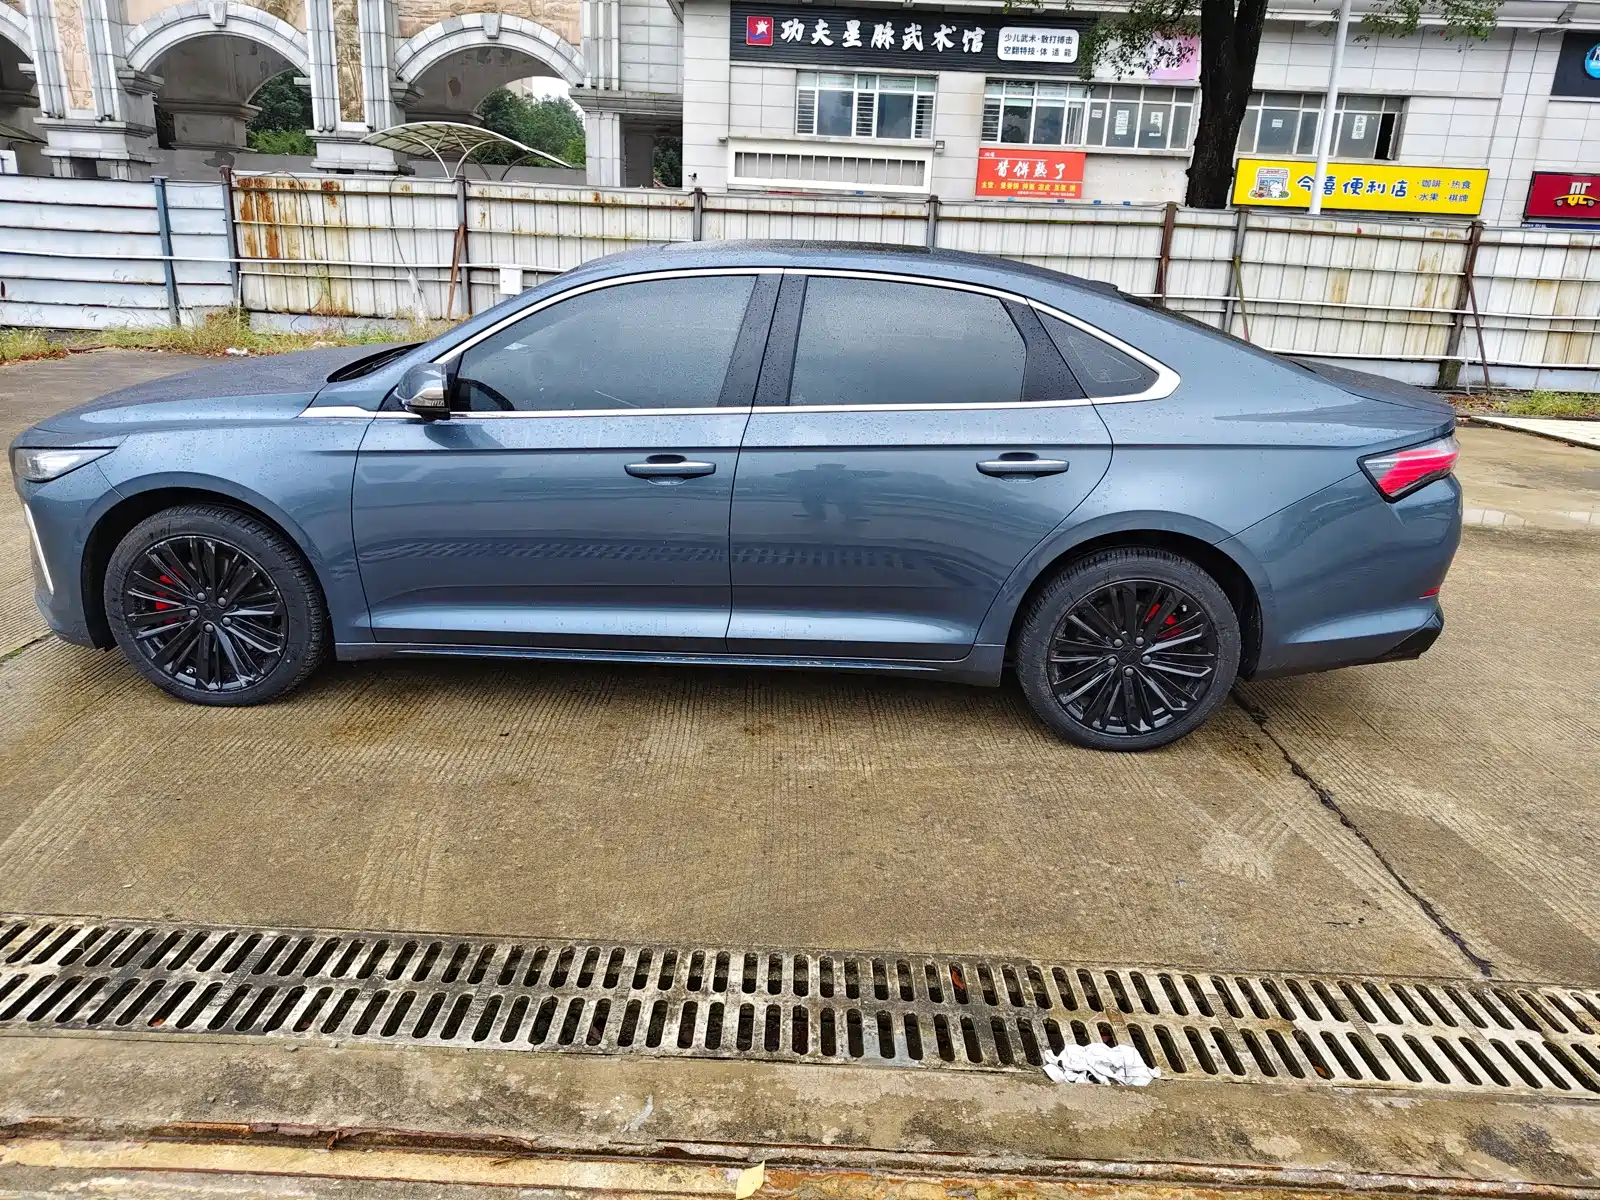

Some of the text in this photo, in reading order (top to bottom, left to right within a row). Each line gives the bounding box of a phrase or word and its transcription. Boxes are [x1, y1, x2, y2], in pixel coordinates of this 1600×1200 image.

[780, 18, 986, 53] 功夫星脉武术馆
